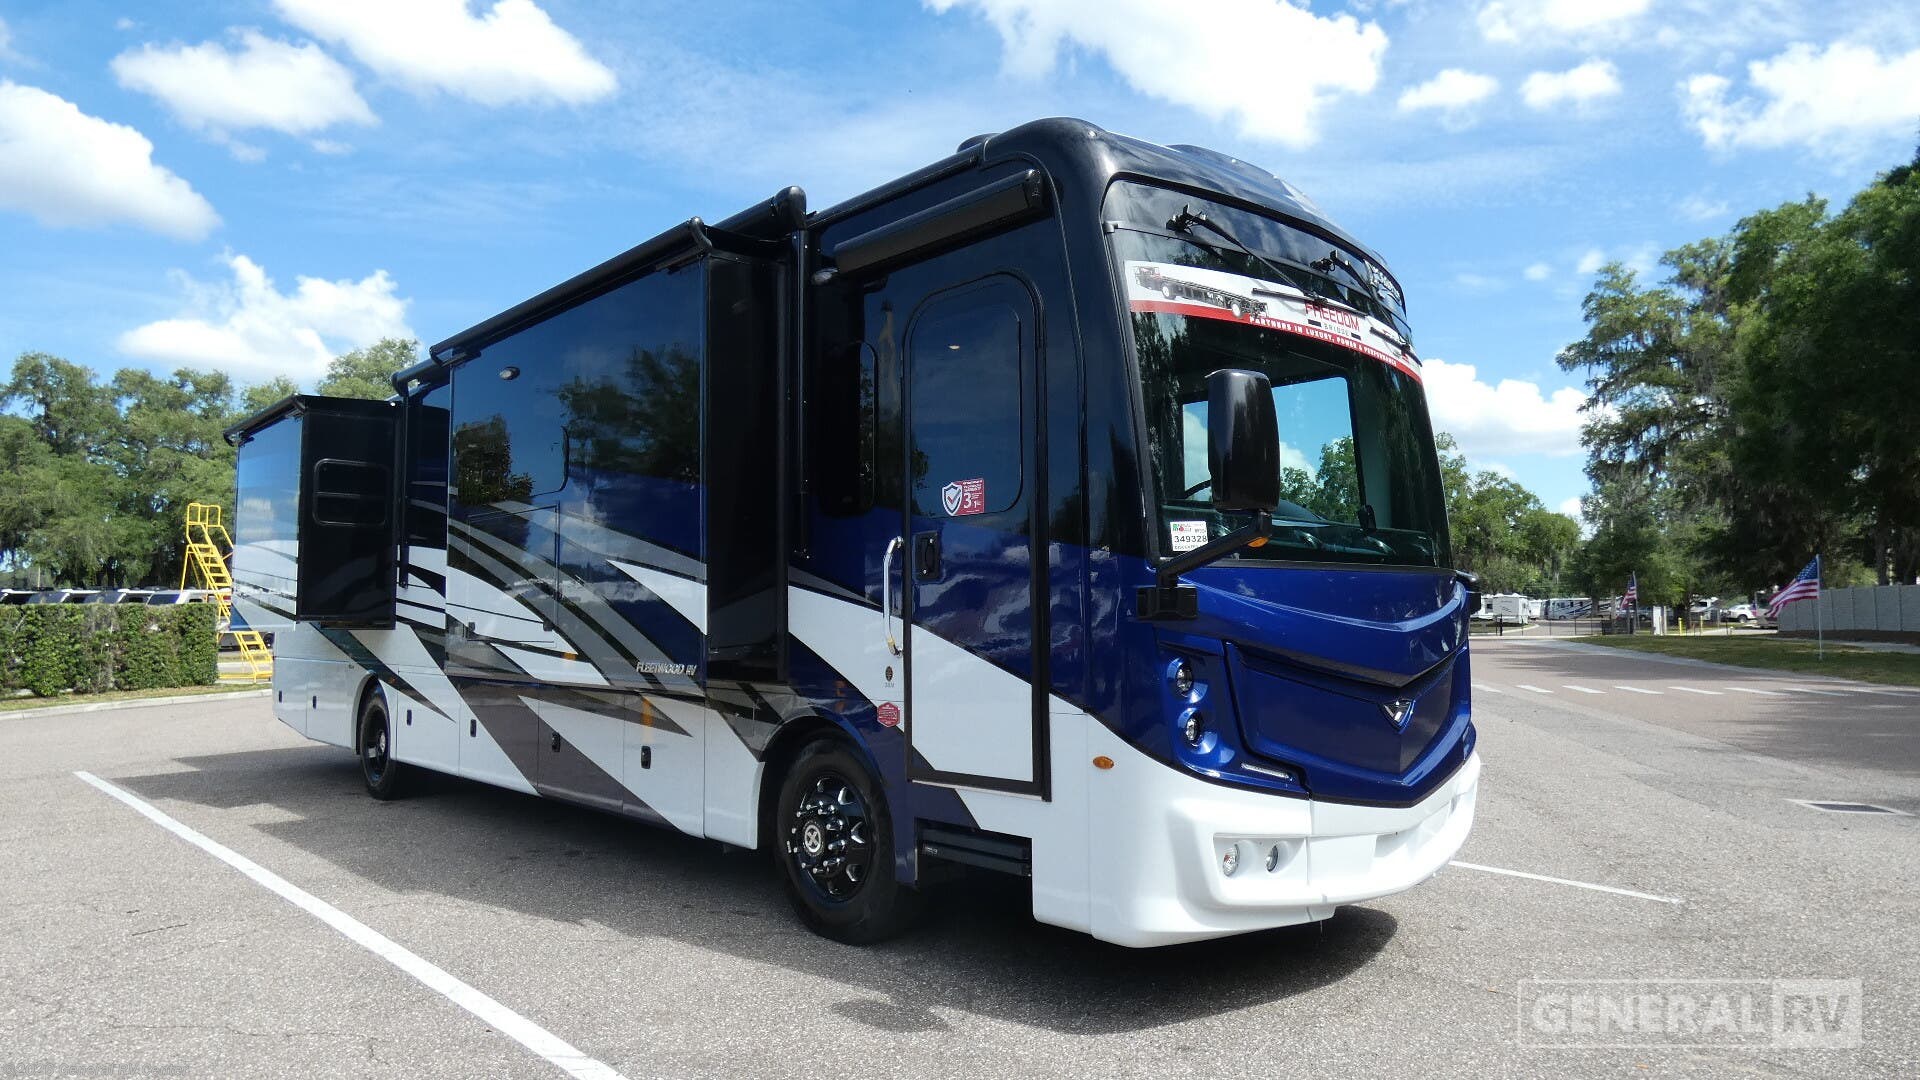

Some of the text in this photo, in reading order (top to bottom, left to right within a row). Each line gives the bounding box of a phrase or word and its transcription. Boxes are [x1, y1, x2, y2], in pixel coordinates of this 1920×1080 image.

[1305, 303, 1360, 331] FREEDOM
[1250, 316, 1292, 331] PARTNERS
[1294, 325, 1303, 333] IN
[1336, 336, 1357, 349] POWER
[963, 492, 972, 509] 3
[1174, 535, 1208, 543] 349328
[636, 661, 697, 676] FLEETWOOD RV
